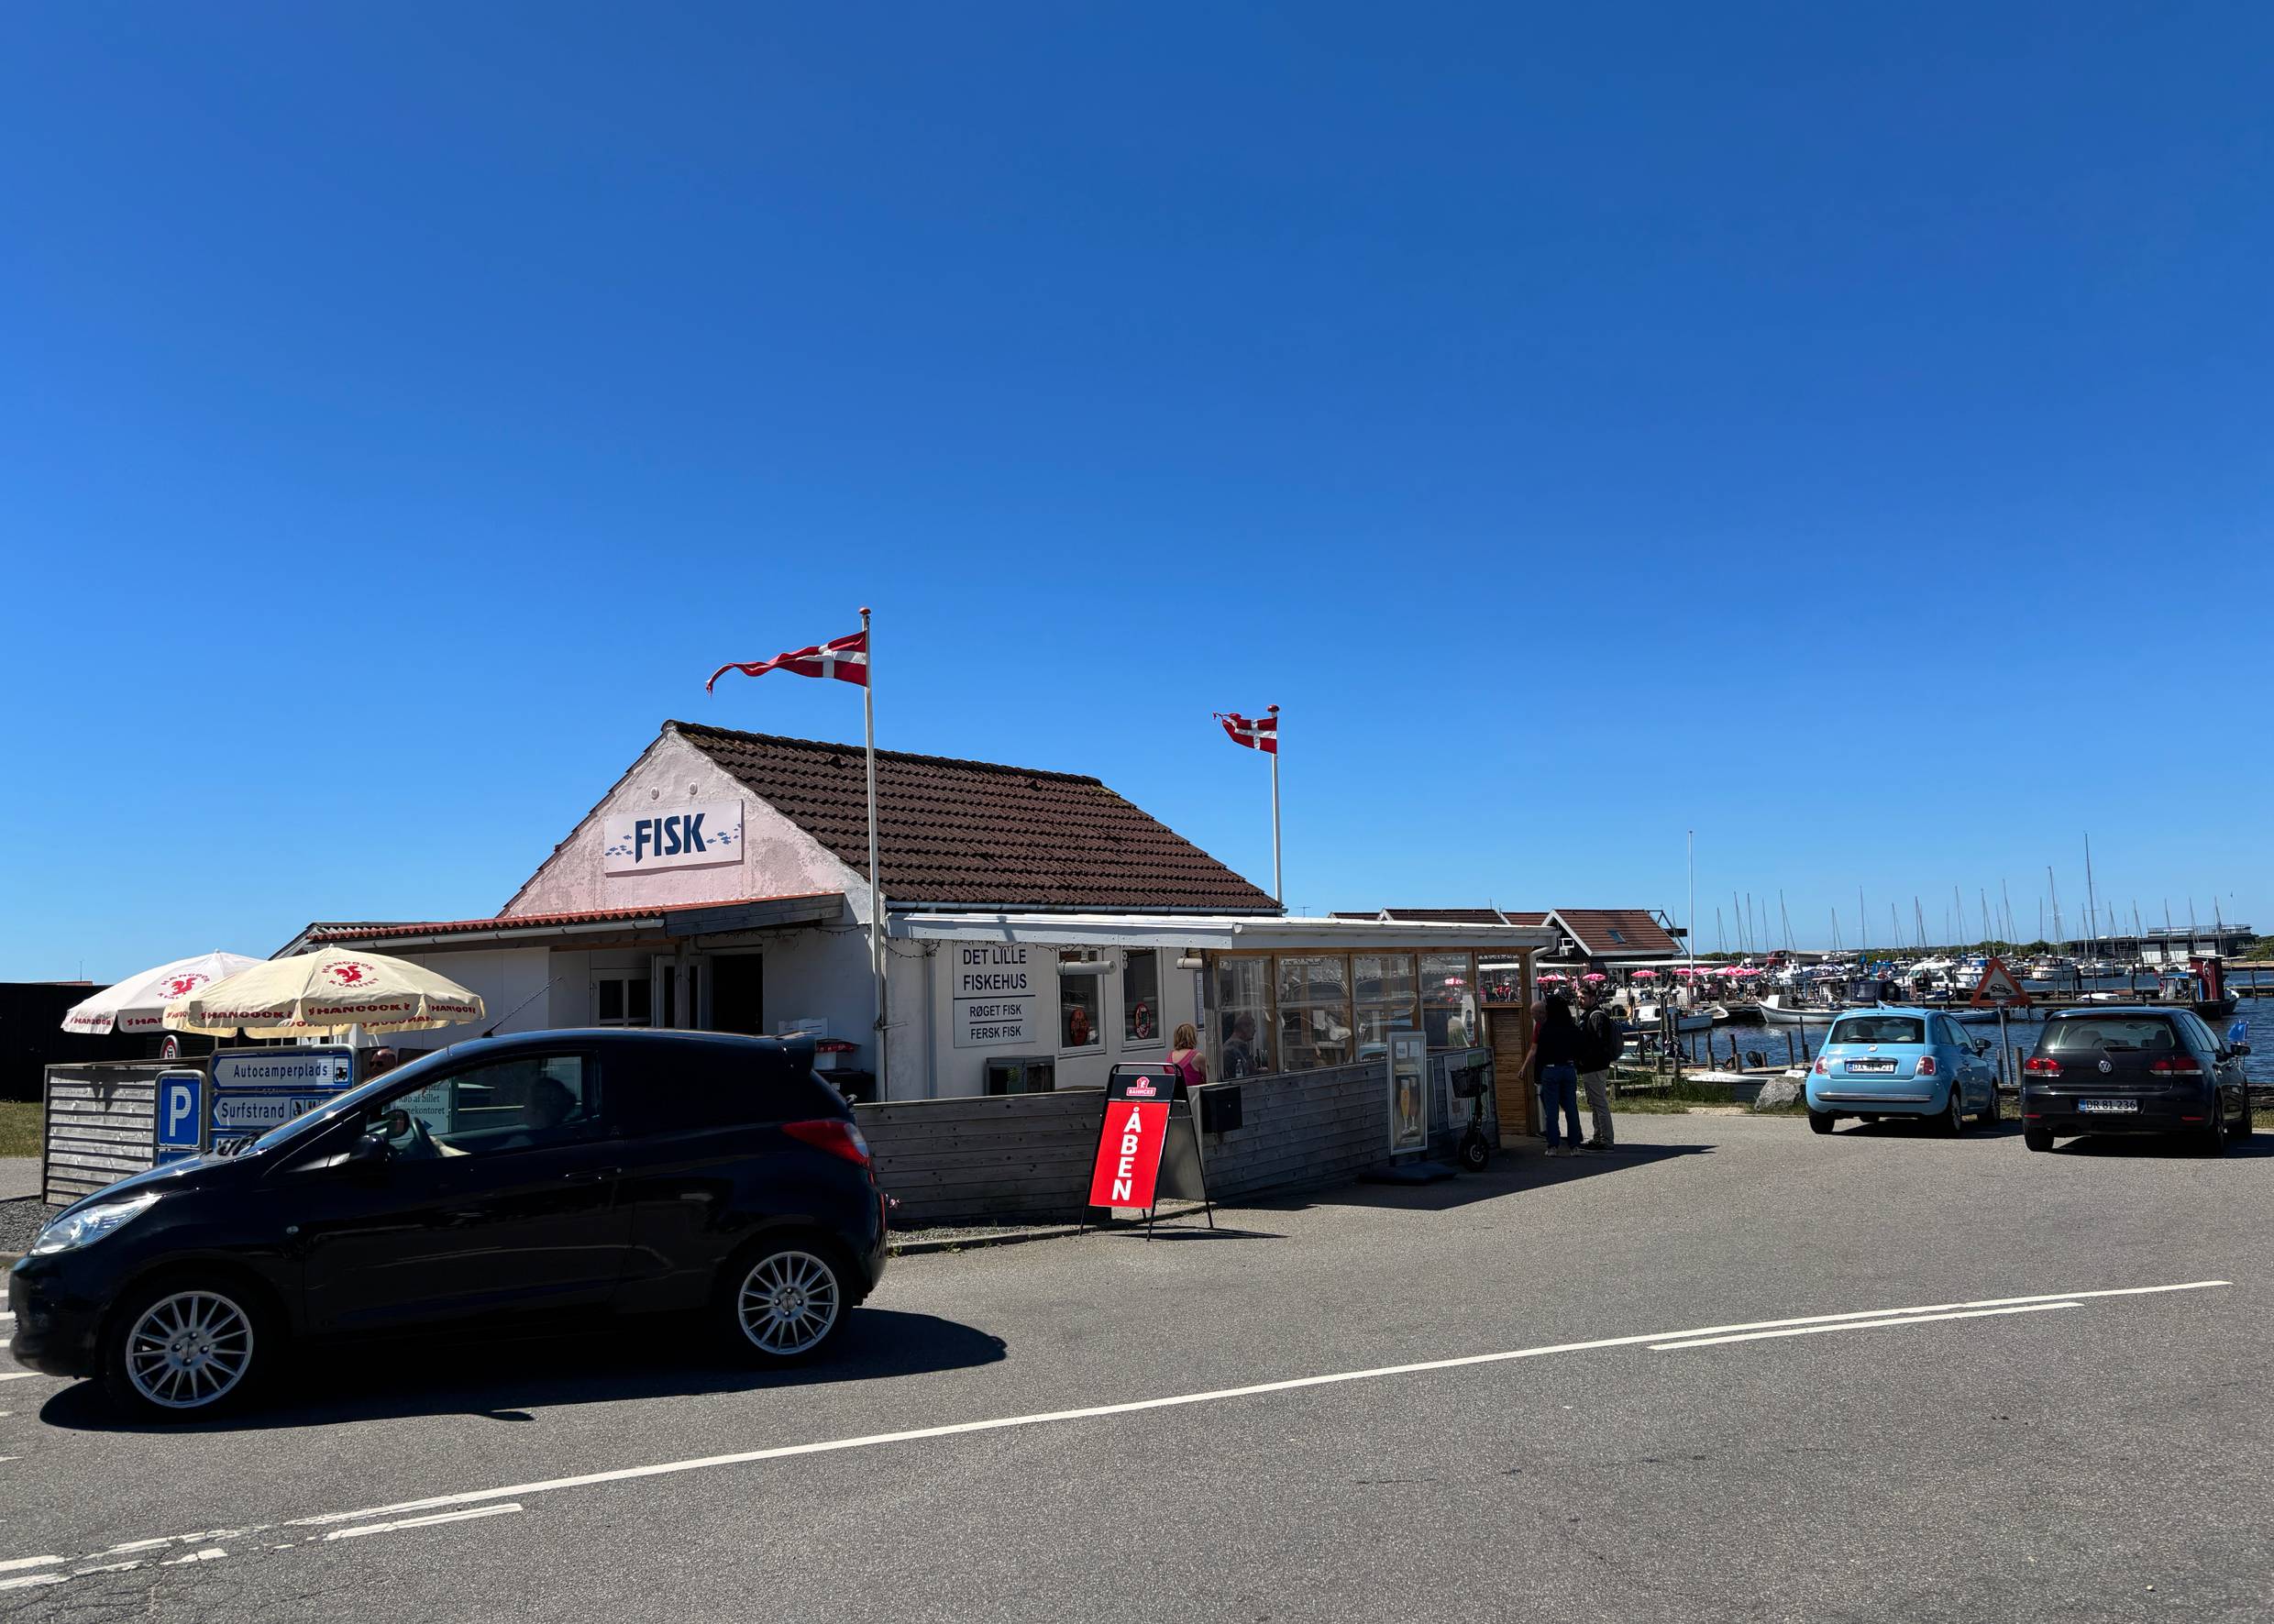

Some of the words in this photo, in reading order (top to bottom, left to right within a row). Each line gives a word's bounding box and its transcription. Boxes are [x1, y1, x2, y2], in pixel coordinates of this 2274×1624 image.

[635, 812, 707, 864] FISK
[963, 948, 988, 965] DET
[993, 948, 1027, 965] LILLE
[321, 960, 376, 974] HANCOCK
[963, 974, 1027, 990] FISKEHUS
[207, 1011, 284, 1020] HANCOCK
[316, 1003, 402, 1015] HANCOCK
[969, 1005, 1000, 1017] RØGET
[1002, 1004, 1022, 1015] FISK
[970, 1027, 1000, 1040] FERSK
[1002, 1025, 1022, 1037] FISK
[234, 1062, 328, 1081] Autocamperplads
[169, 1086, 192, 1137] P
[221, 1102, 285, 1119] Surfstrand
[2086, 1100, 2099, 1110] DR
[2103, 1100, 2113, 1110] 81
[2116, 1100, 2136, 1110] 236
[1111, 1106, 1143, 1201] ÅBEN
